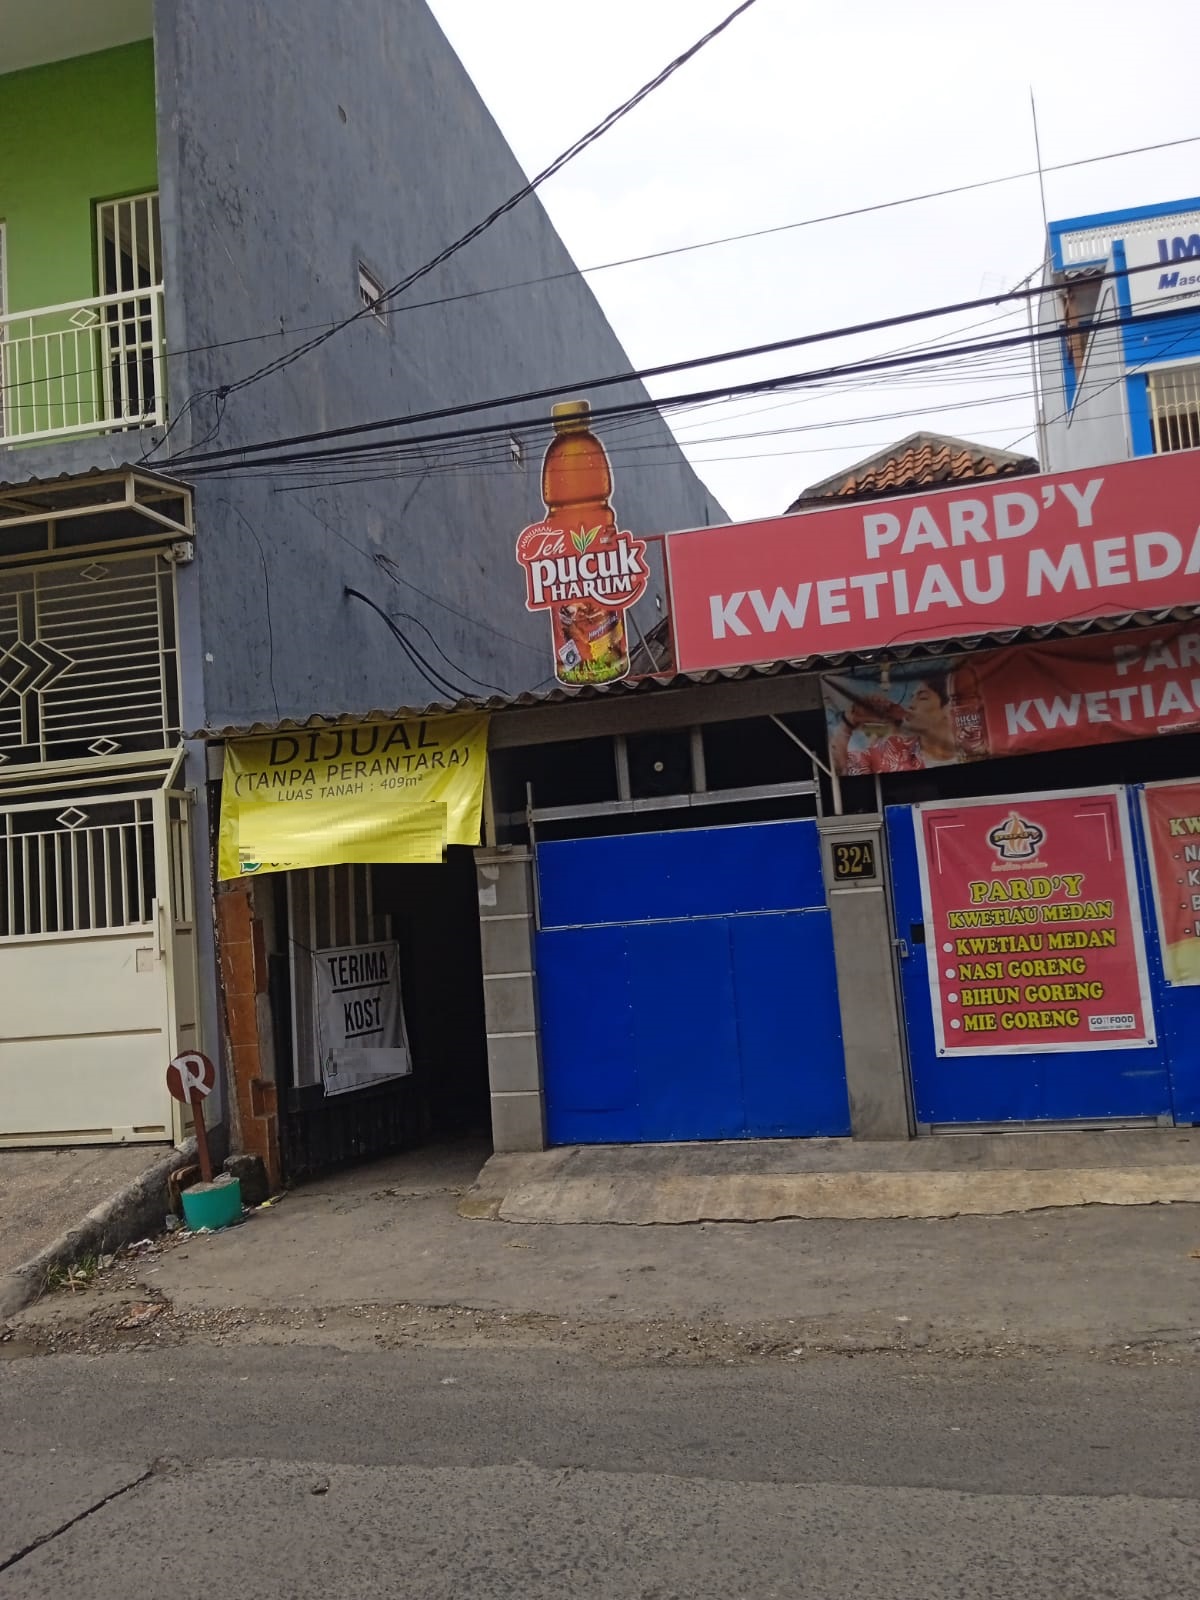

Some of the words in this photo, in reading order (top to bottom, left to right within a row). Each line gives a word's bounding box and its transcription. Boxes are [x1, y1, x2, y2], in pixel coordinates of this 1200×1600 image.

[863, 478, 1105, 560] PARD'Y
[522, 530, 567, 560] Teh
[551, 575, 640, 605] HARUM
[709, 556, 1005, 639] KWETIAU
[269, 720, 440, 766] DIJUAL
[234, 767, 317, 797] (TANPA
[327, 747, 469, 783] PERANTARA)
[277, 788, 313, 802] LUAS
[320, 783, 363, 799] TANAH
[970, 874, 1084, 903] PARD'Y
[949, 906, 1038, 929] KWETIAU
[1042, 901, 1113, 923] MEDAN
[955, 933, 1044, 956] KWETIAU
[1048, 929, 1117, 951] MEDAN
[328, 950, 389, 986] TERIMA
[958, 962, 1004, 981] NASI
[1007, 957, 1086, 978] GORENG
[961, 986, 1020, 1006] BIHUN
[1024, 982, 1104, 1003] GORENG
[343, 997, 382, 1032] KOST
[963, 1013, 998, 1032] MIE
[1001, 1009, 1080, 1030] GORENG
